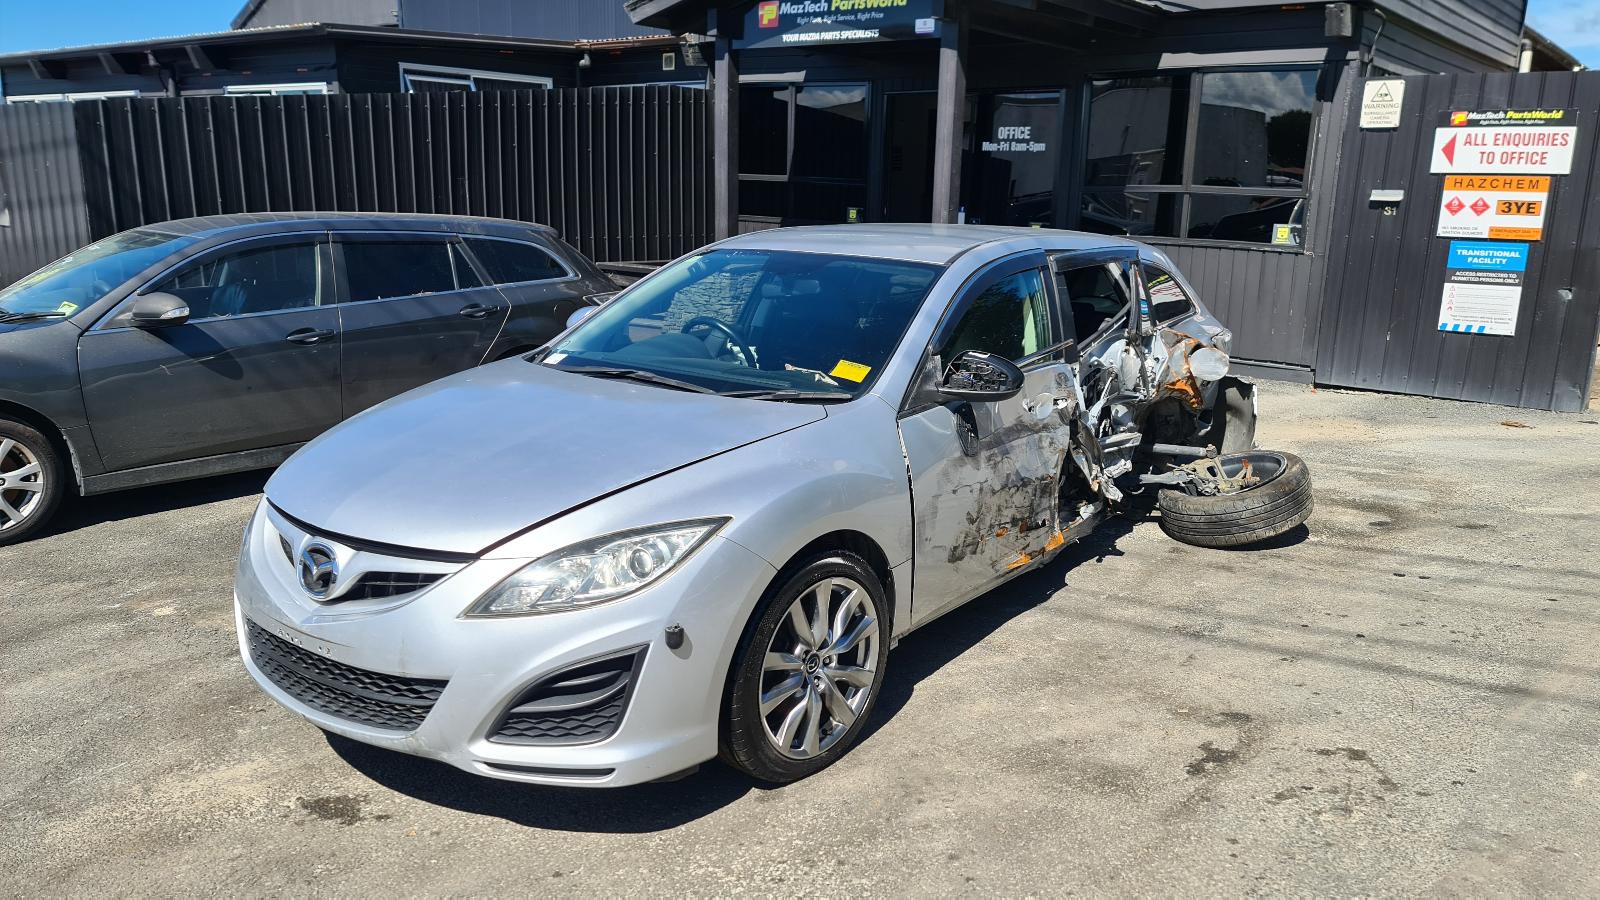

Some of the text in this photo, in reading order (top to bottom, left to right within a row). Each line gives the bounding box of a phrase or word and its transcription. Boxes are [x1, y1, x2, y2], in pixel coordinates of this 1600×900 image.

[780, 1, 828, 14] MazTech
[782, 29, 879, 42] YOUR MAZDA PARTS SPECIALISTS
[1506, 110, 1564, 119] PartsWorld
[997, 126, 1031, 139] OFFICE
[1464, 132, 1569, 147] ALL ENQUIRIES
[982, 141, 1046, 152] Mon-Fri 8am-5pm
[1479, 151, 1548, 165] TO OFFICE
[1453, 178, 1540, 190] HAZCHEM
[1501, 201, 1537, 214] 3YE
[1456, 249, 1521, 258] TRANSITIONAL
